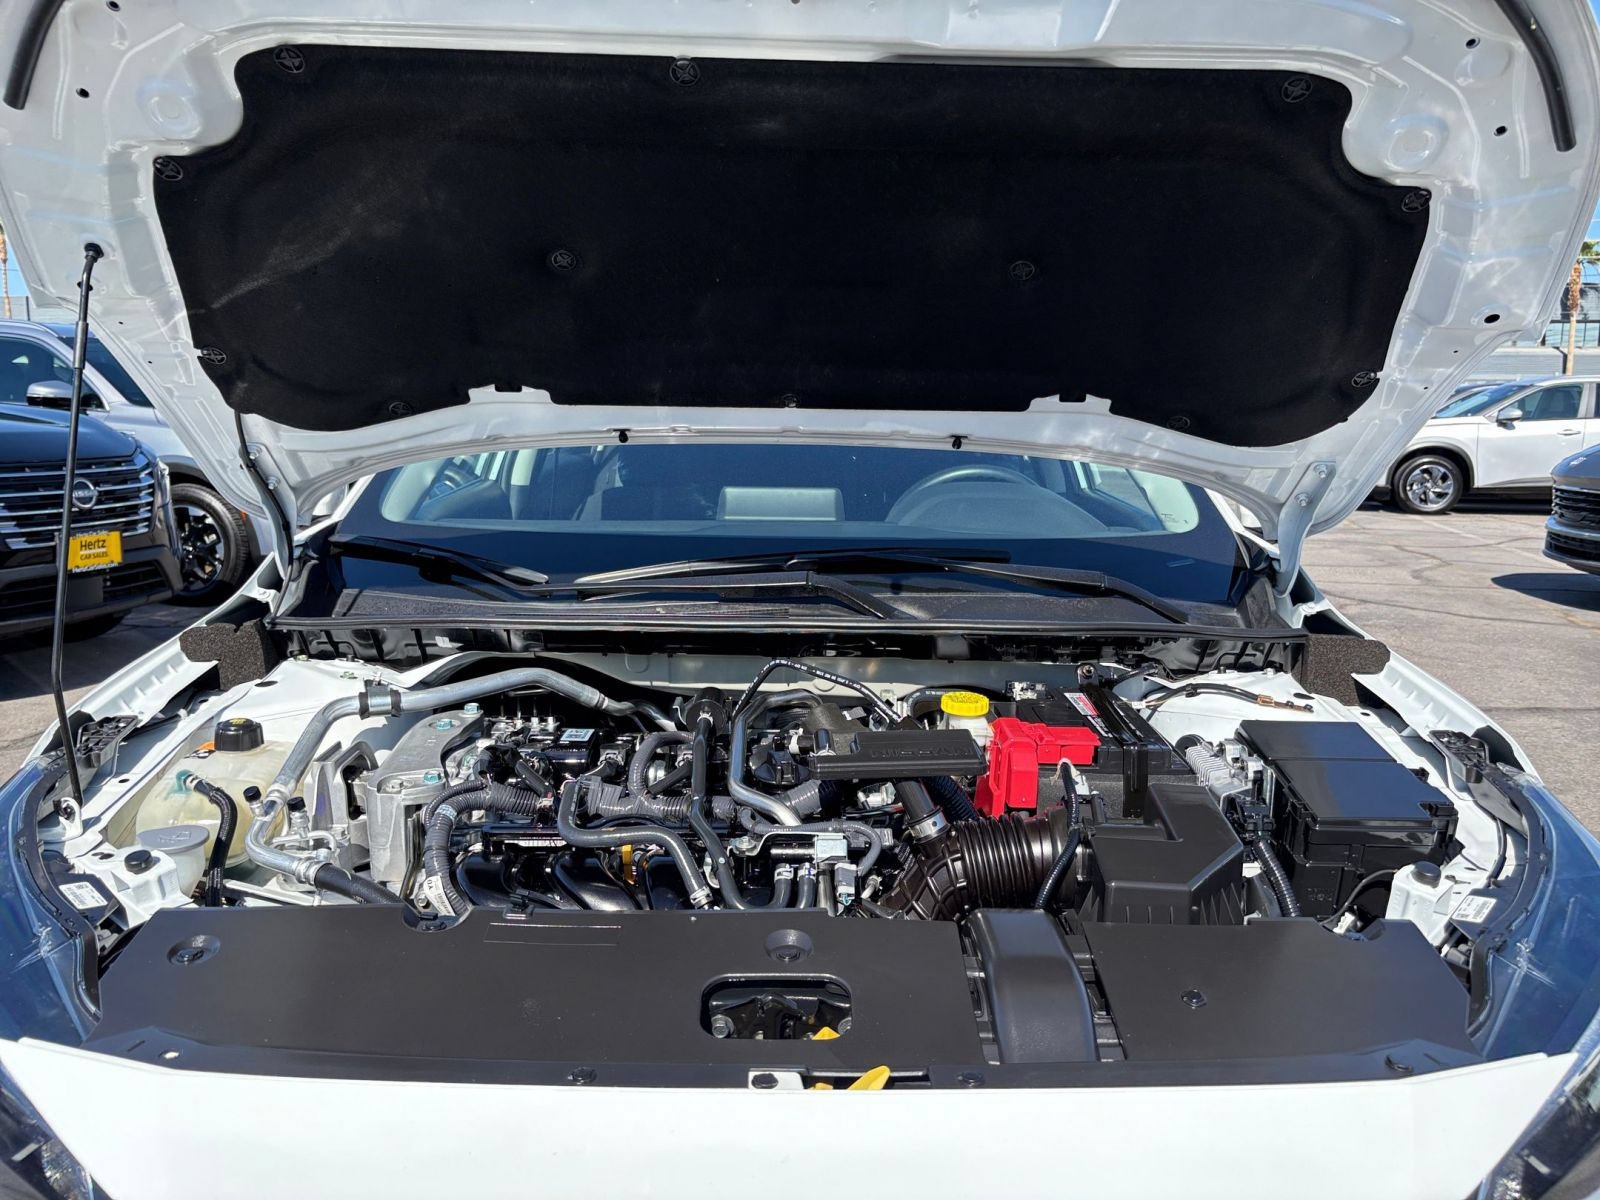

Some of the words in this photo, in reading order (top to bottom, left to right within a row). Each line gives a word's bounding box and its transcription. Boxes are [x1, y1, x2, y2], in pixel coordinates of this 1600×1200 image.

[80, 538, 106, 551] Hertz
[80, 553, 92, 561] CAR
[92, 551, 109, 560] SALES
